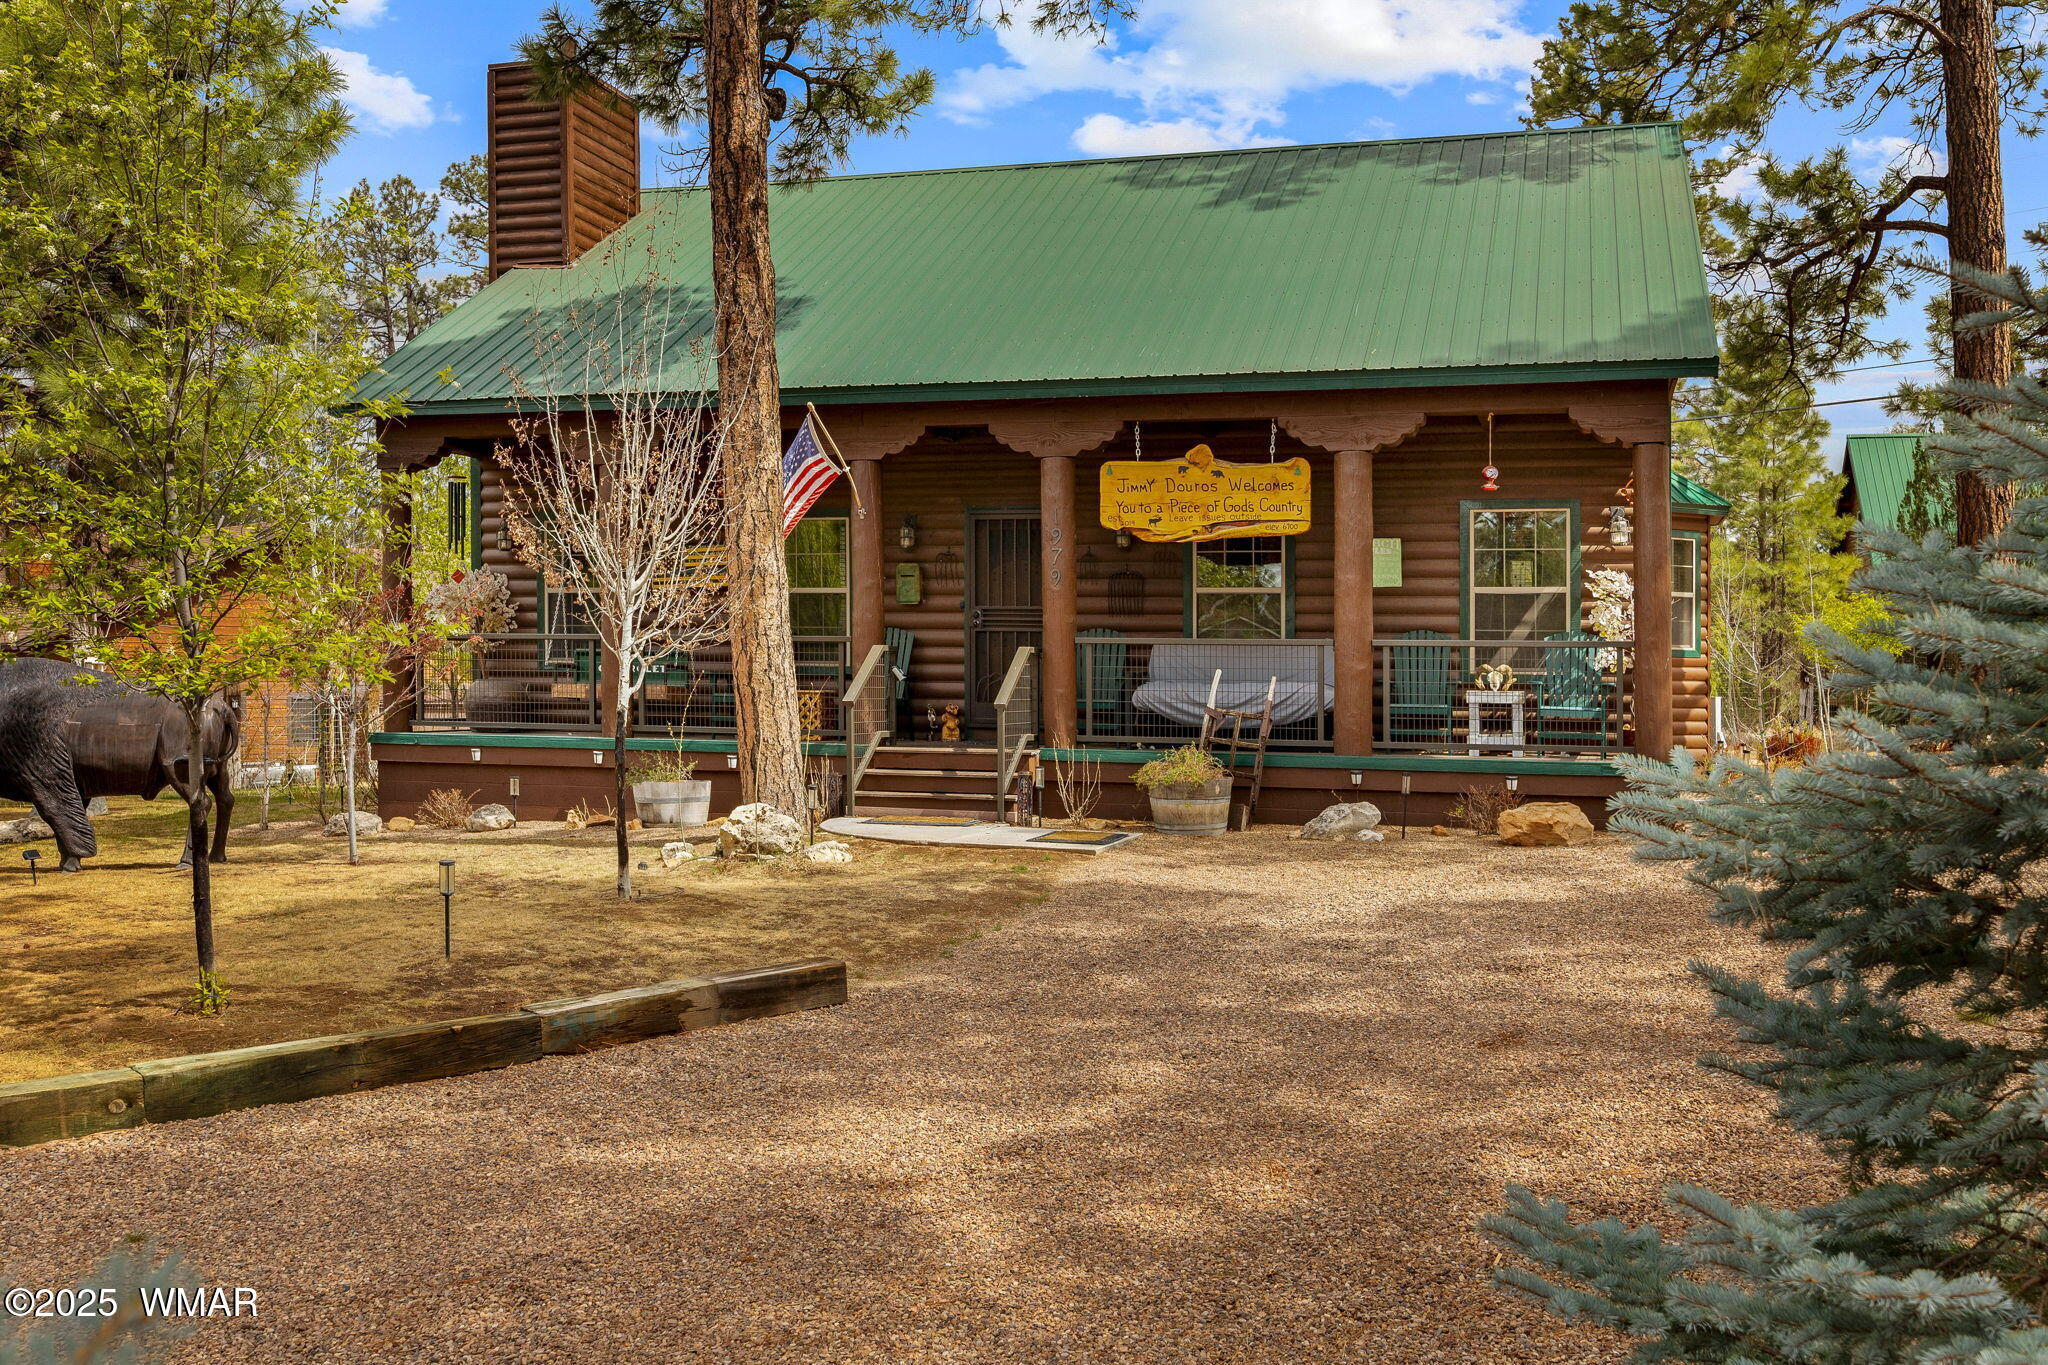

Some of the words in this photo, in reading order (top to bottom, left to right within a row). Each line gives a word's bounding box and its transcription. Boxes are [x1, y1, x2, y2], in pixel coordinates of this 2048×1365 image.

[1166, 478, 1218, 493] Douros
[1156, 504, 1163, 513] a
[1170, 498, 1201, 514] Piece
[1259, 497, 1303, 516] Country
